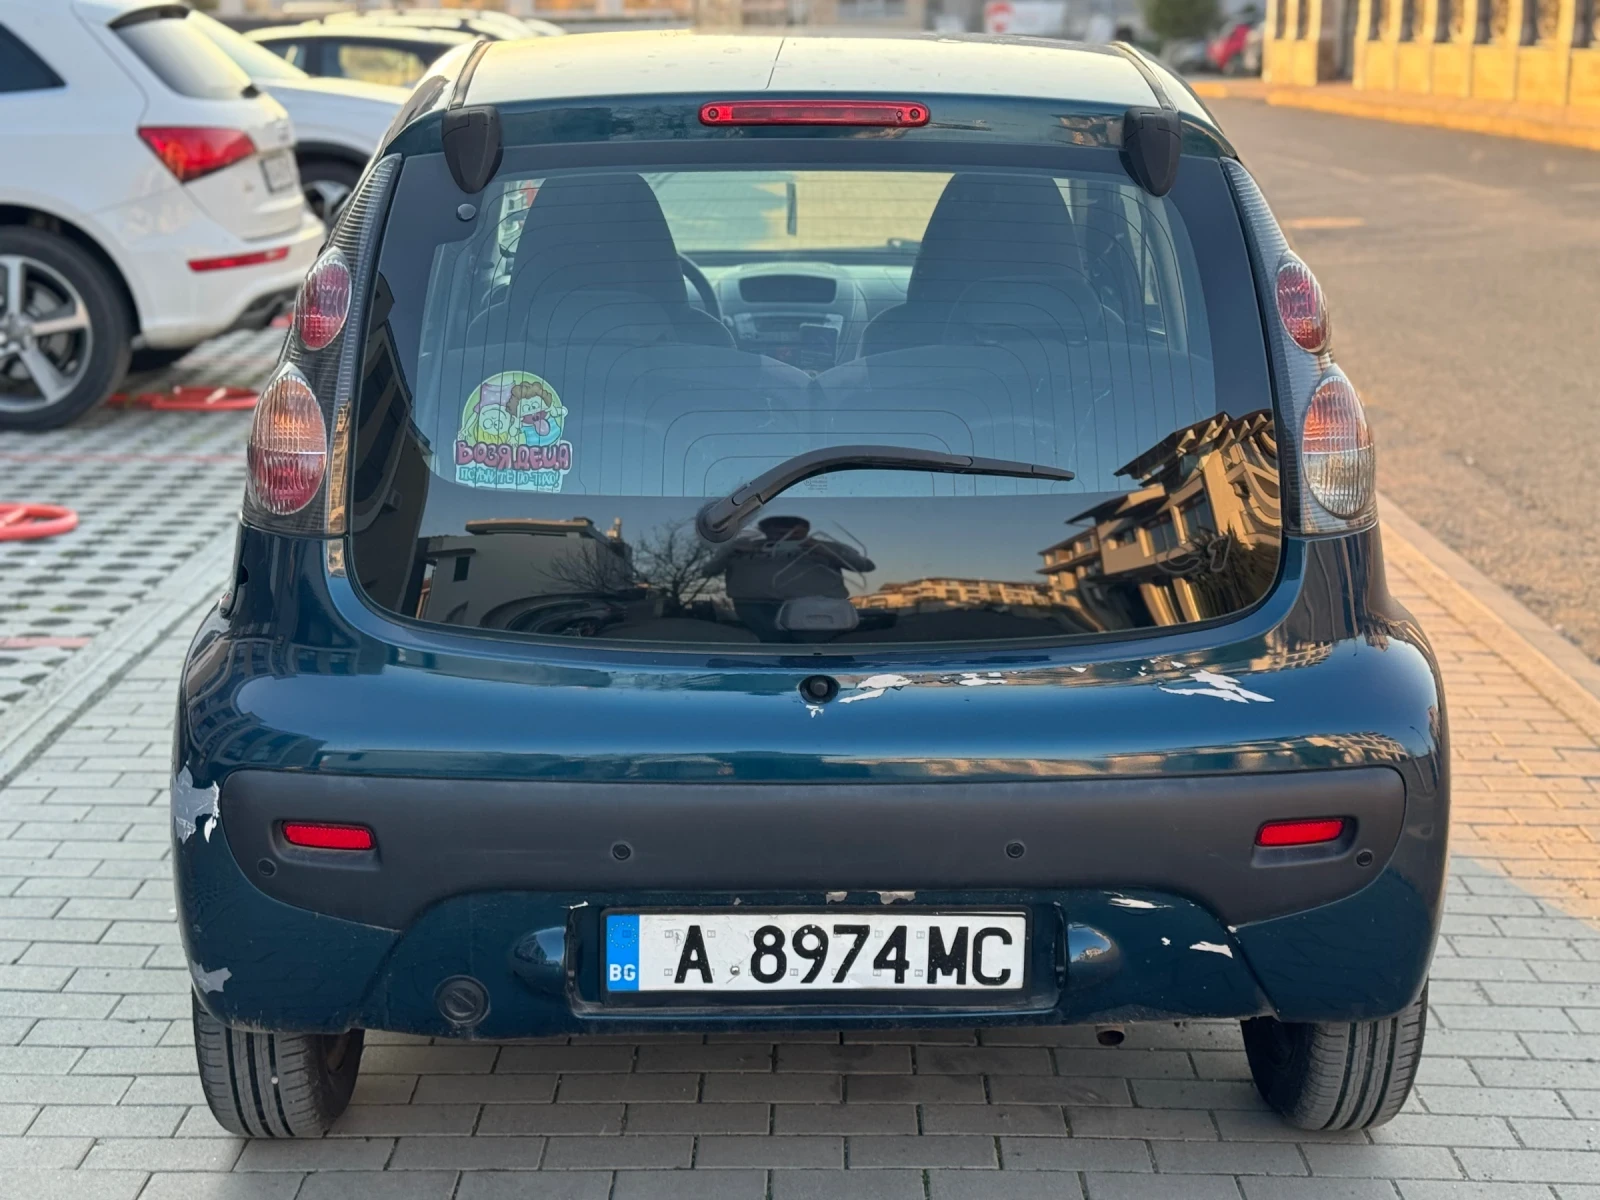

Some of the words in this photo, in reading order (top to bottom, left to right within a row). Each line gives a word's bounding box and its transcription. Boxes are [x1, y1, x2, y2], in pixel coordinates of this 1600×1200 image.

[456, 441, 512, 470] ВОЗЯ
[513, 443, 571, 471] ДЕЦА
[674, 924, 714, 984] A
[750, 924, 910, 985] 8974
[926, 925, 1013, 986] MC
[609, 964, 637, 982] BG
